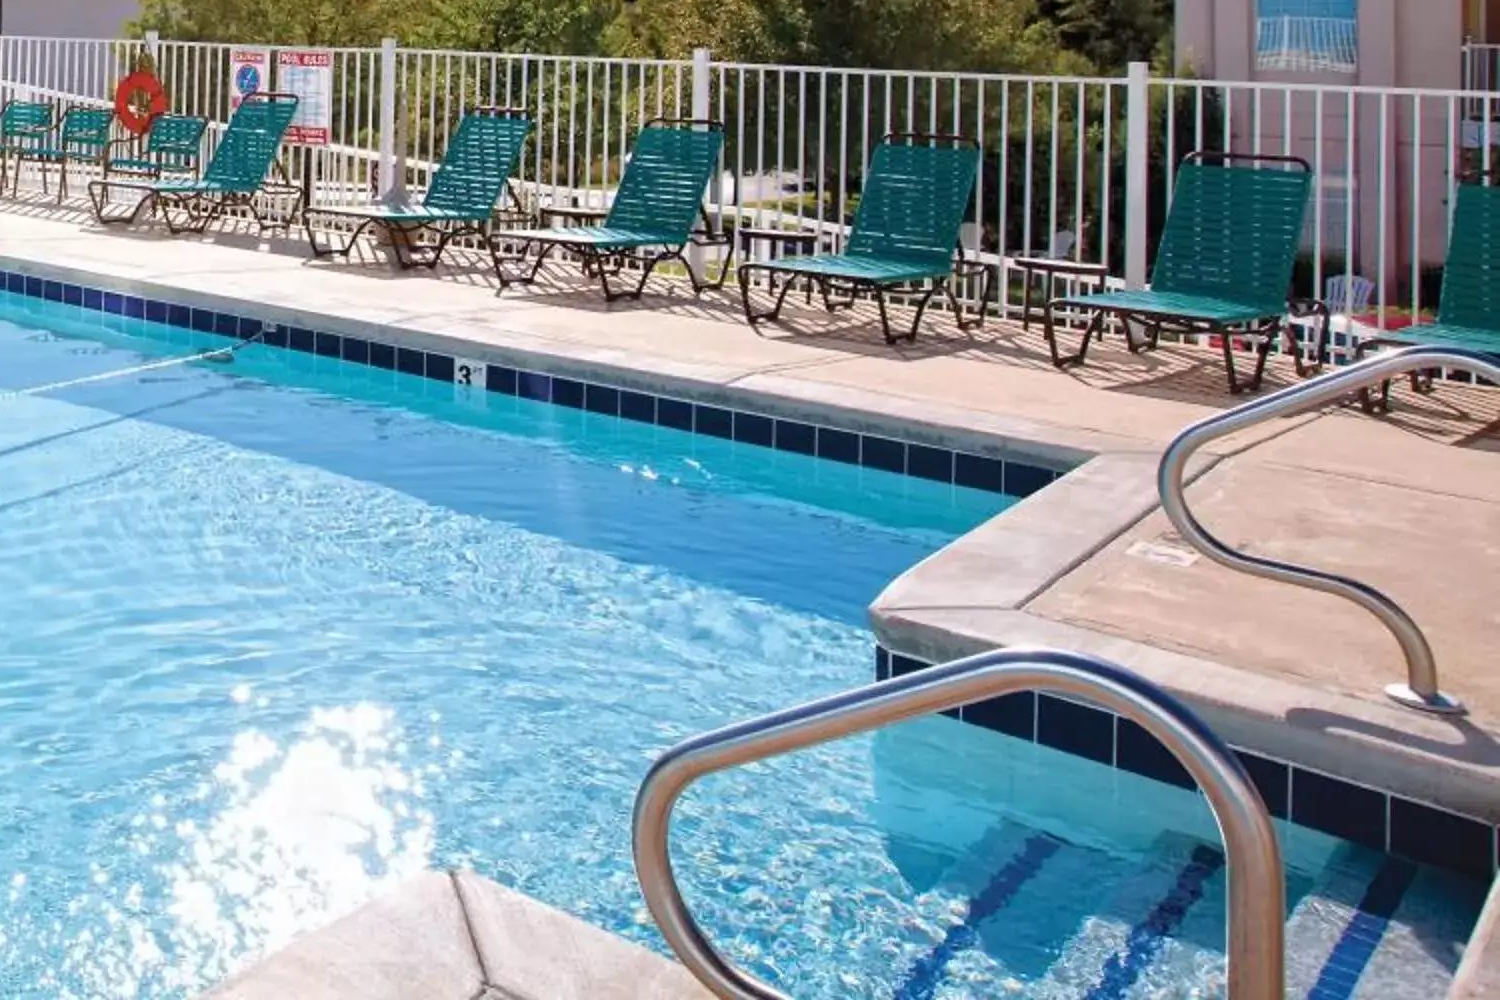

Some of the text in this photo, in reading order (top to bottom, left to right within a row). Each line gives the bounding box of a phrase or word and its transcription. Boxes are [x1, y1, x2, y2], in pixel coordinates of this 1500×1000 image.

[280, 53, 329, 66] POOL RULES
[457, 364, 472, 386] 3
